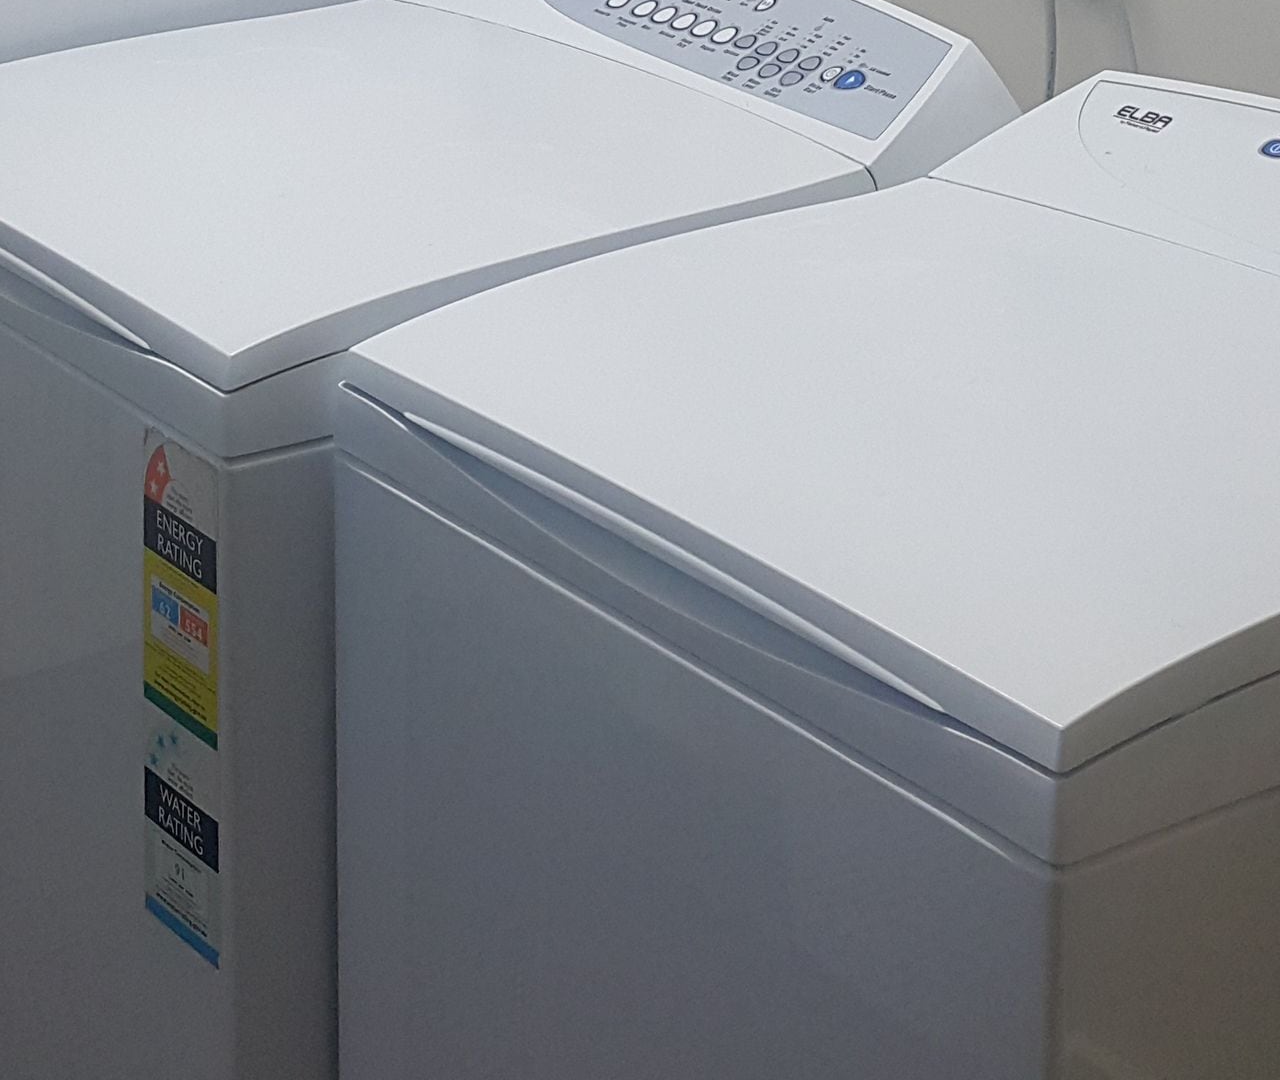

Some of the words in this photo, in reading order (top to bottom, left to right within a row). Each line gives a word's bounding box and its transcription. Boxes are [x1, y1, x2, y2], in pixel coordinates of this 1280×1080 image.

[1116, 105, 1173, 128] ELBA
[156, 509, 204, 556] ENERGY
[157, 536, 203, 580] RATING
[159, 783, 202, 833] WATER
[158, 810, 204, 857] RATING
